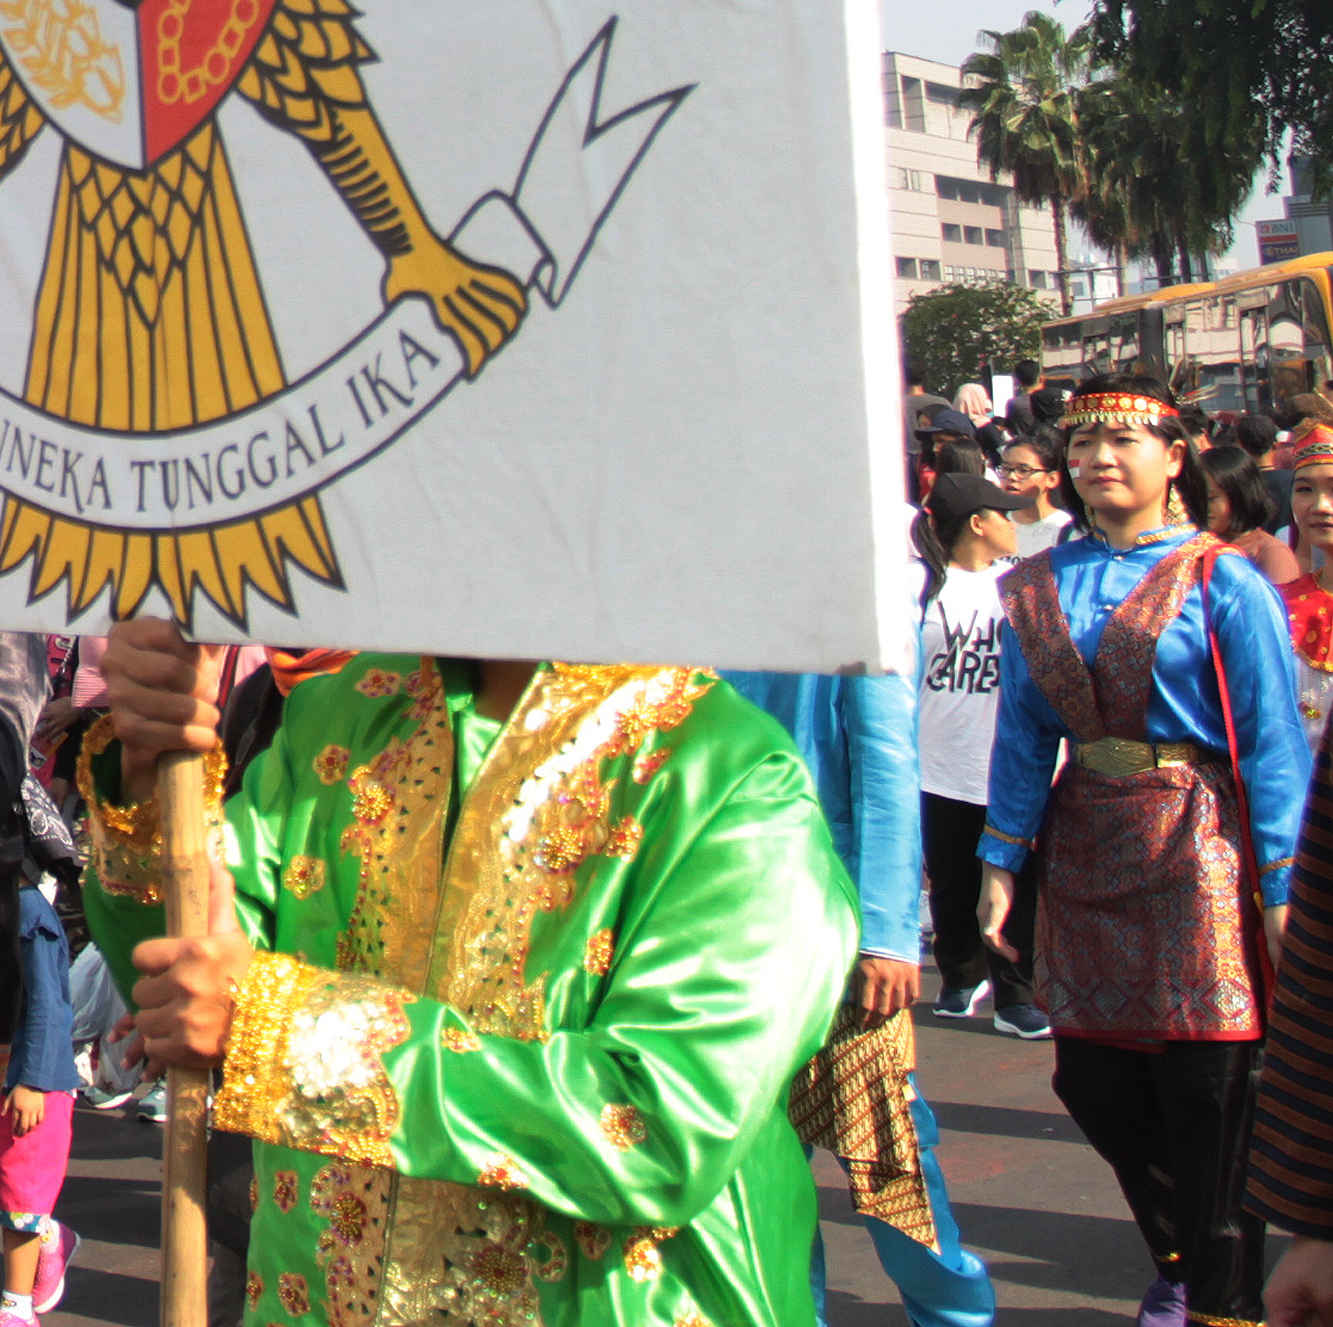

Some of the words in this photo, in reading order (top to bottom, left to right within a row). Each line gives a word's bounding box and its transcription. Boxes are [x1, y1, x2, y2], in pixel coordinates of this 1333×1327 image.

[1271, 222, 1294, 234] BNI
[130, 404, 346, 513] TUNGGAL
[345, 328, 441, 430] IKA
